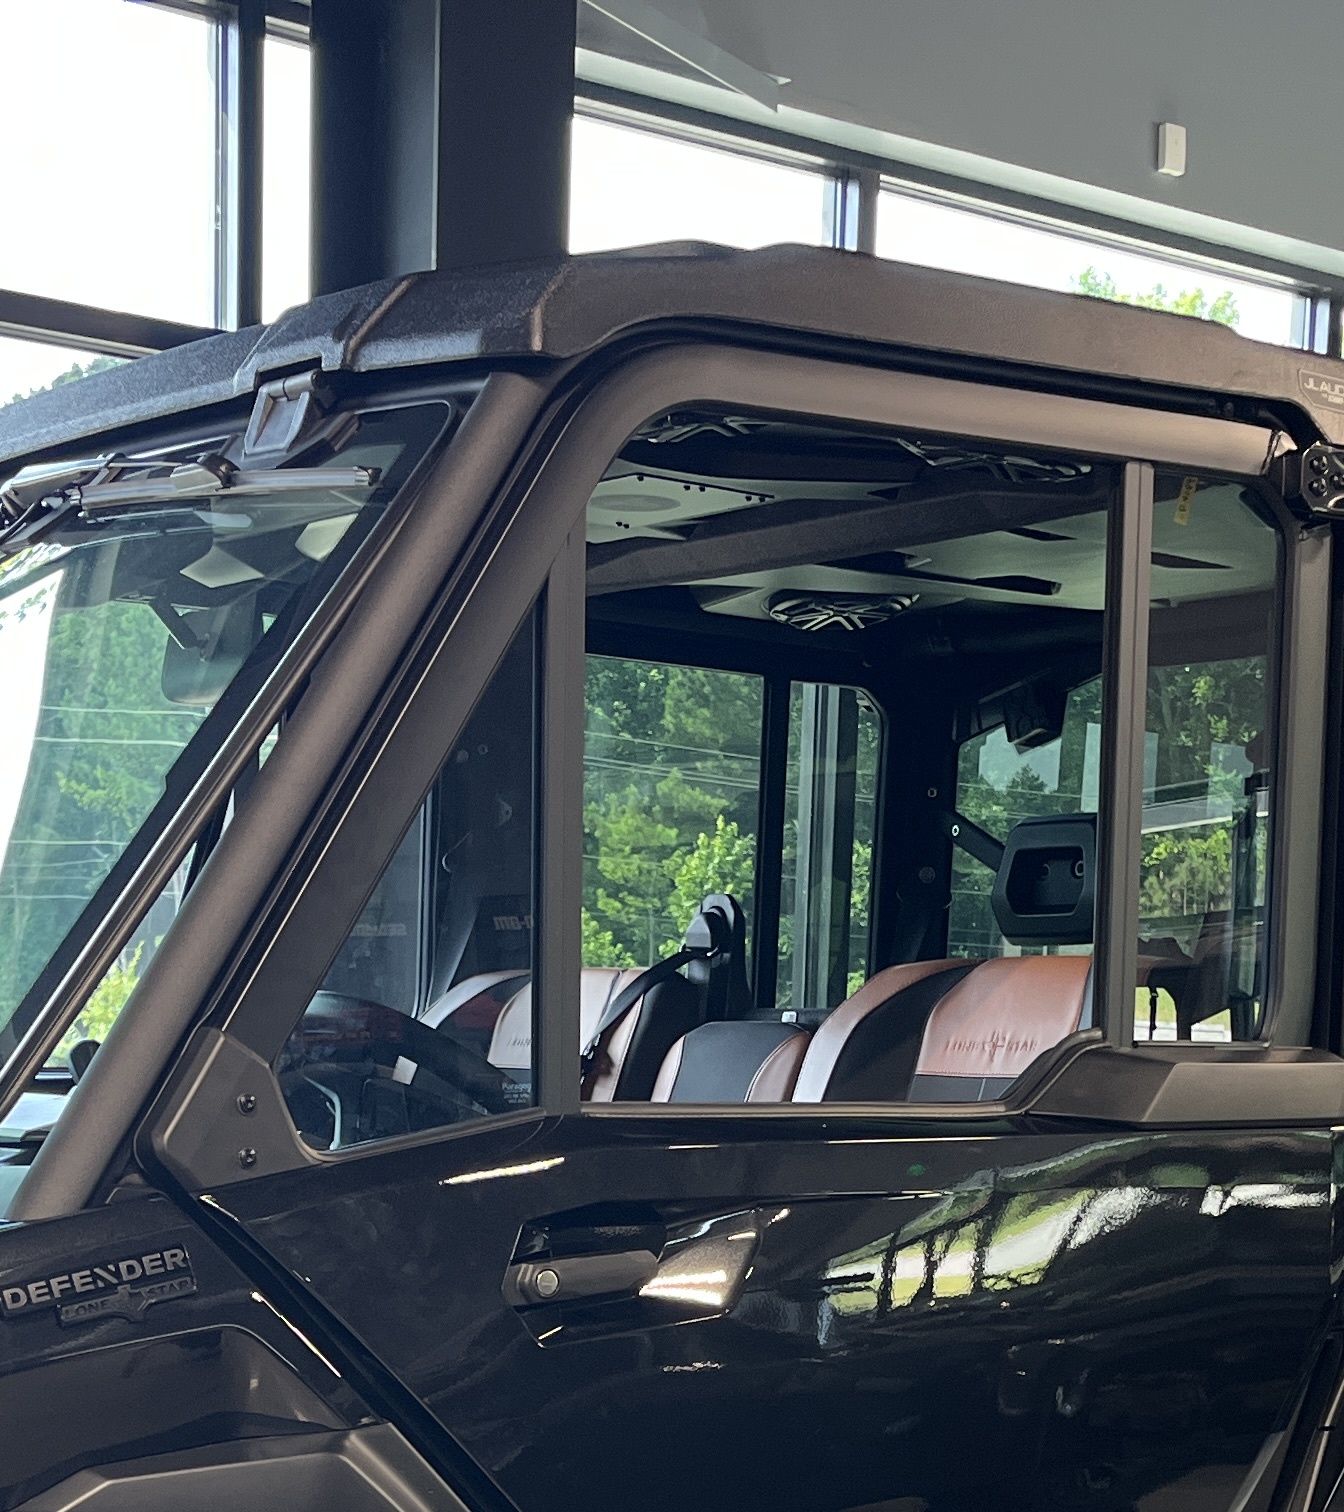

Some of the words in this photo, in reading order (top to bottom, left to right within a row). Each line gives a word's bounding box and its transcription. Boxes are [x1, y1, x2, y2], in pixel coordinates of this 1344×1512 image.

[1303, 377, 1319, 391] JL
[2, 1248, 189, 1310] DEFENDER
[142, 1276, 193, 1299] STAR
